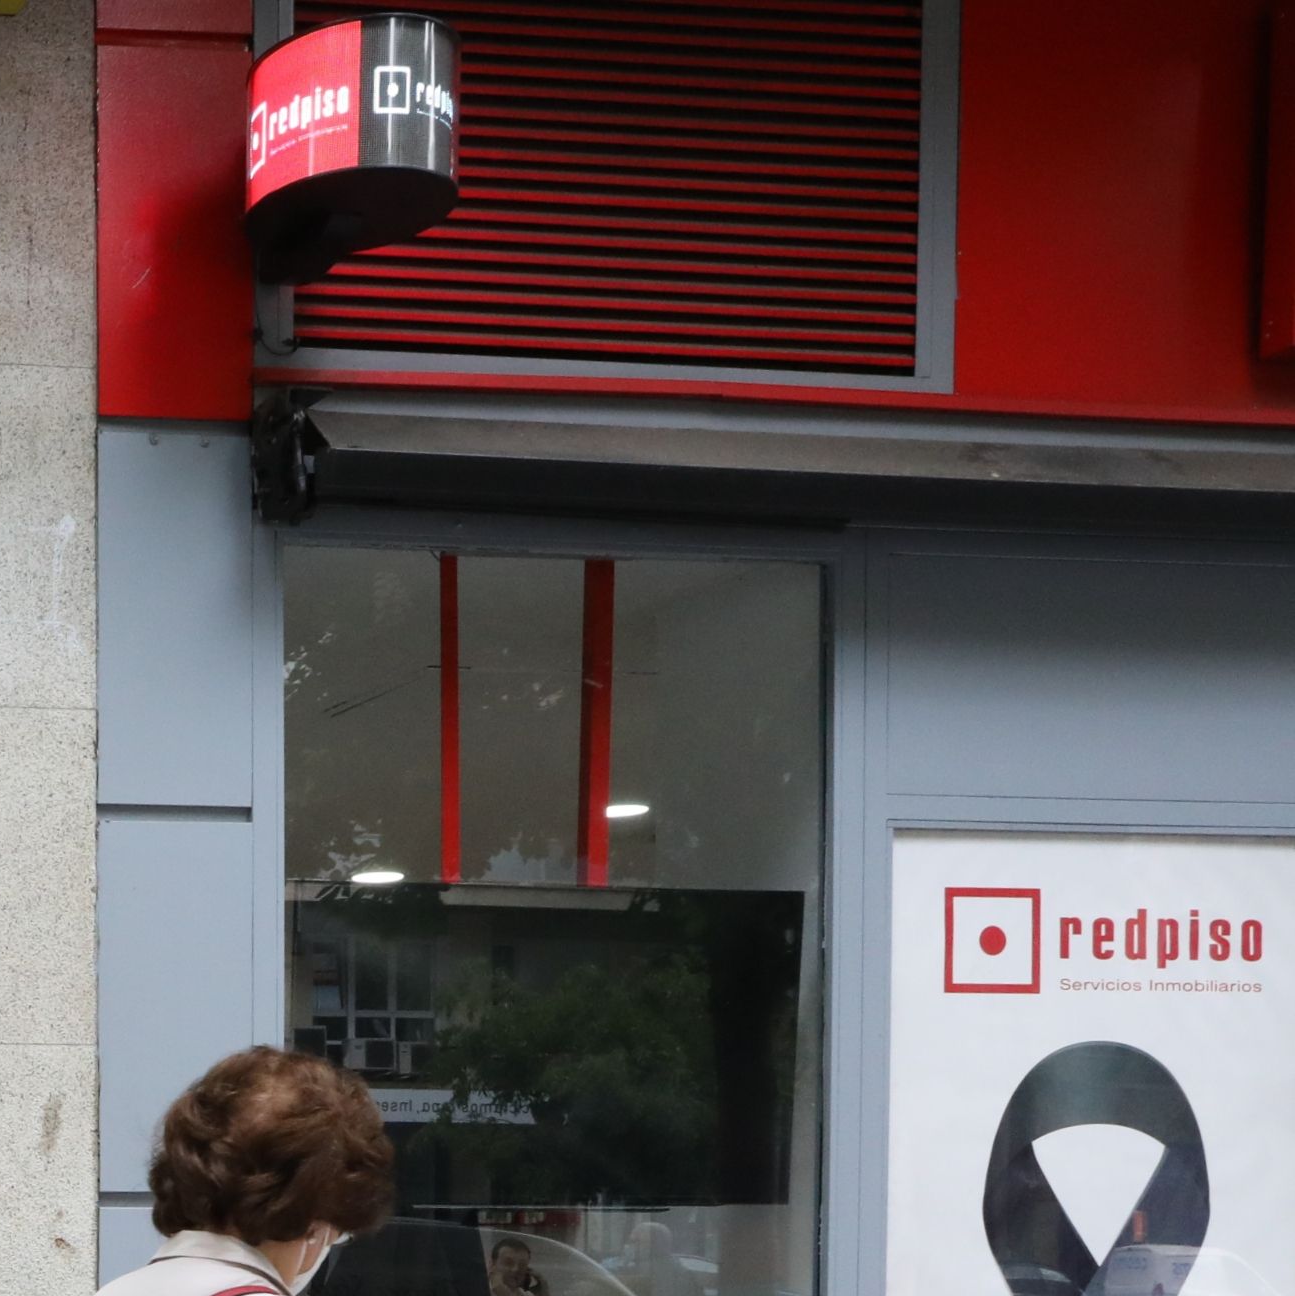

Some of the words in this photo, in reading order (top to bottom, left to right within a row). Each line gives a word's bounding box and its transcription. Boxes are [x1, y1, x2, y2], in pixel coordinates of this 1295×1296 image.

[268, 85, 349, 140] redpiso
[1059, 909, 1263, 968] redpiso
[1060, 978, 1142, 992] Servicios
[1149, 979, 1263, 993] Inmobiliarios
